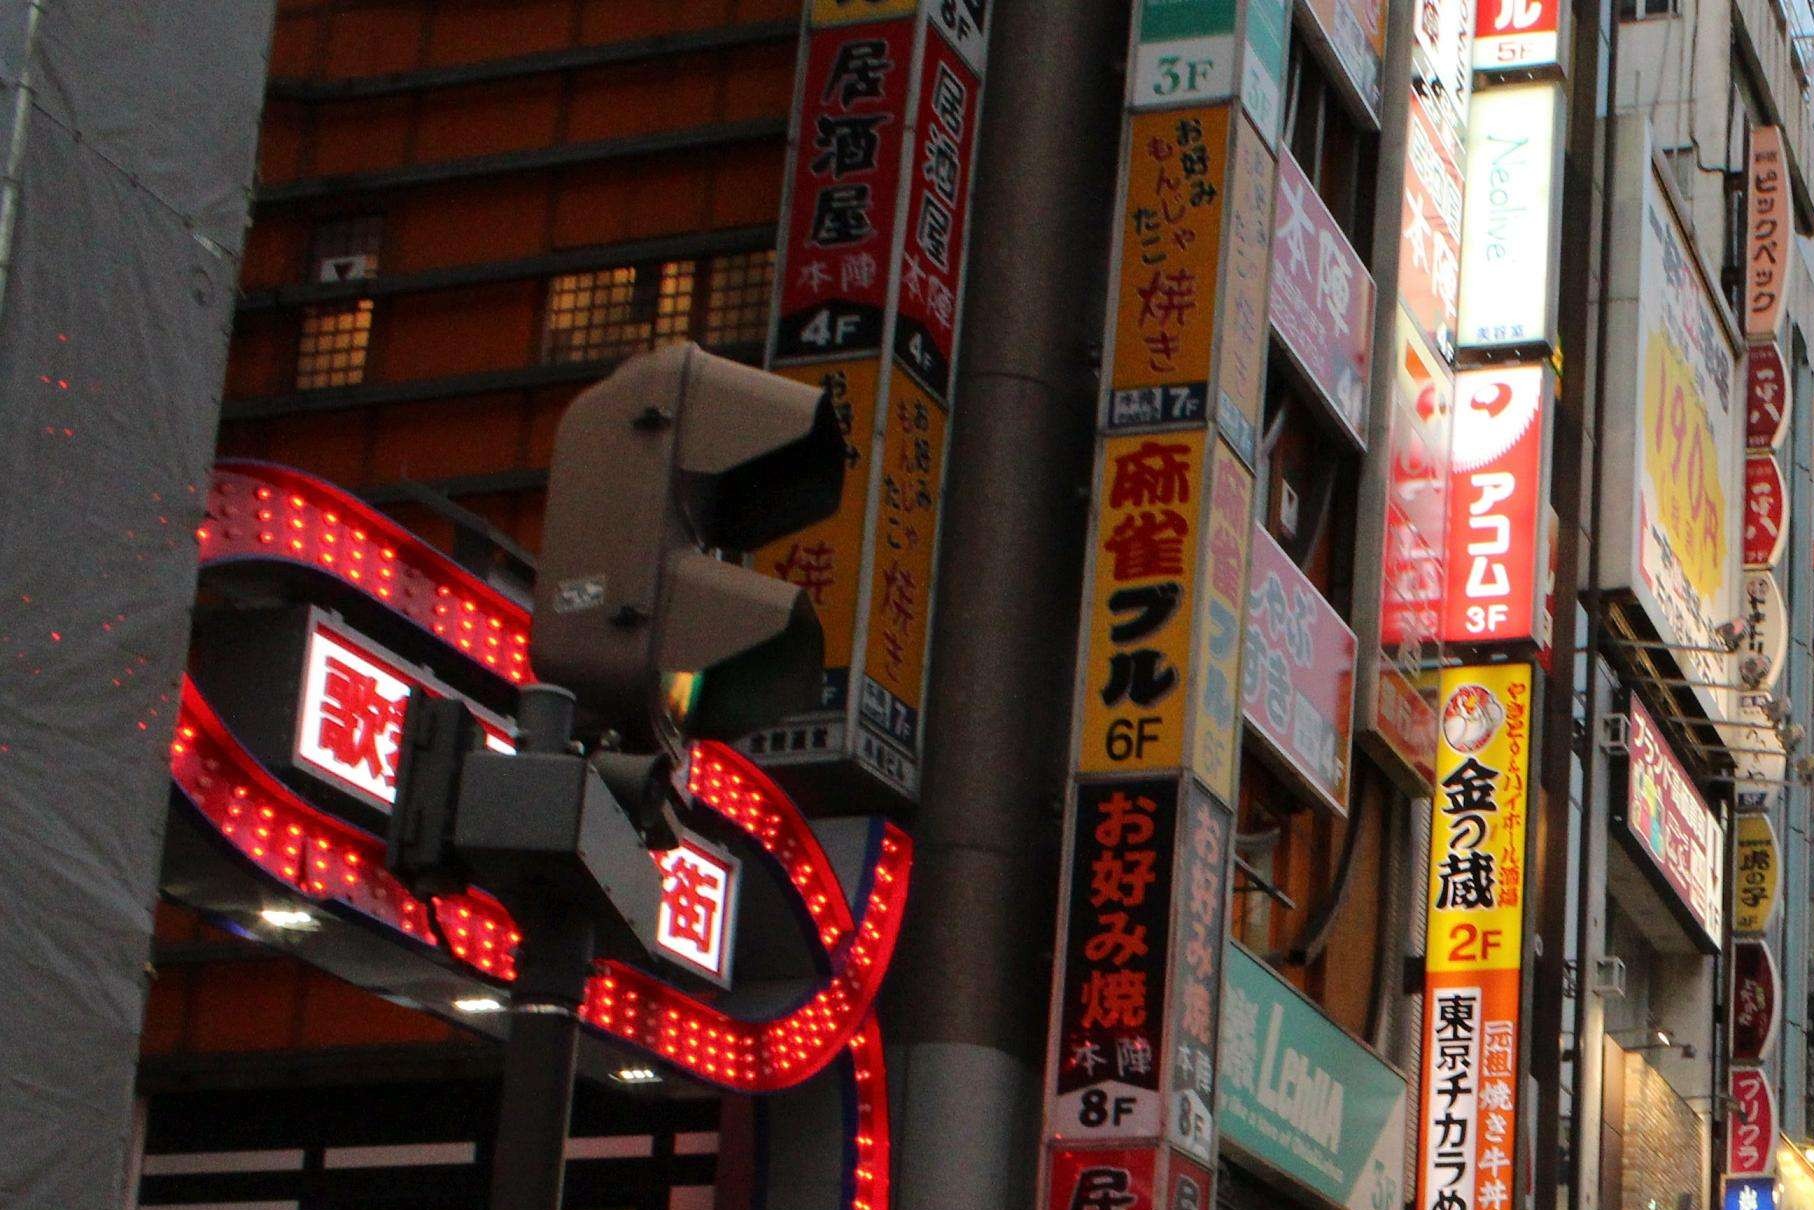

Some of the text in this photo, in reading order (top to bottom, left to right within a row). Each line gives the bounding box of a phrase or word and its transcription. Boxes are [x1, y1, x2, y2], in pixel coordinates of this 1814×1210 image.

[1152, 54, 1215, 96] 3F
[809, 38, 895, 249] 居酒屋
[915, 59, 967, 274] 居酒屋
[1175, 117, 1217, 208] お好み
[1147, 136, 1197, 251] もんじゃ
[799, 252, 877, 294] 本陣
[801, 308, 861, 347] 4F
[909, 333, 933, 370] 4F
[1137, 268, 1195, 374] 焼き
[1465, 471, 1516, 599] アコム
[1464, 604, 1509, 634] 3F
[319, 653, 411, 791] 歌
[1106, 717, 1163, 761] 6F
[1435, 757, 1500, 910] 金の蔵
[661, 852, 720, 954] 街
[1080, 791, 1157, 1029] お好み焼
[1181, 804, 1221, 1045] お好み焼
[1447, 923, 1503, 962] 2F
[1071, 1034, 1154, 1077] 本陣
[1078, 1087, 1138, 1128] 8F
[1178, 1090, 1206, 1142] 8F
